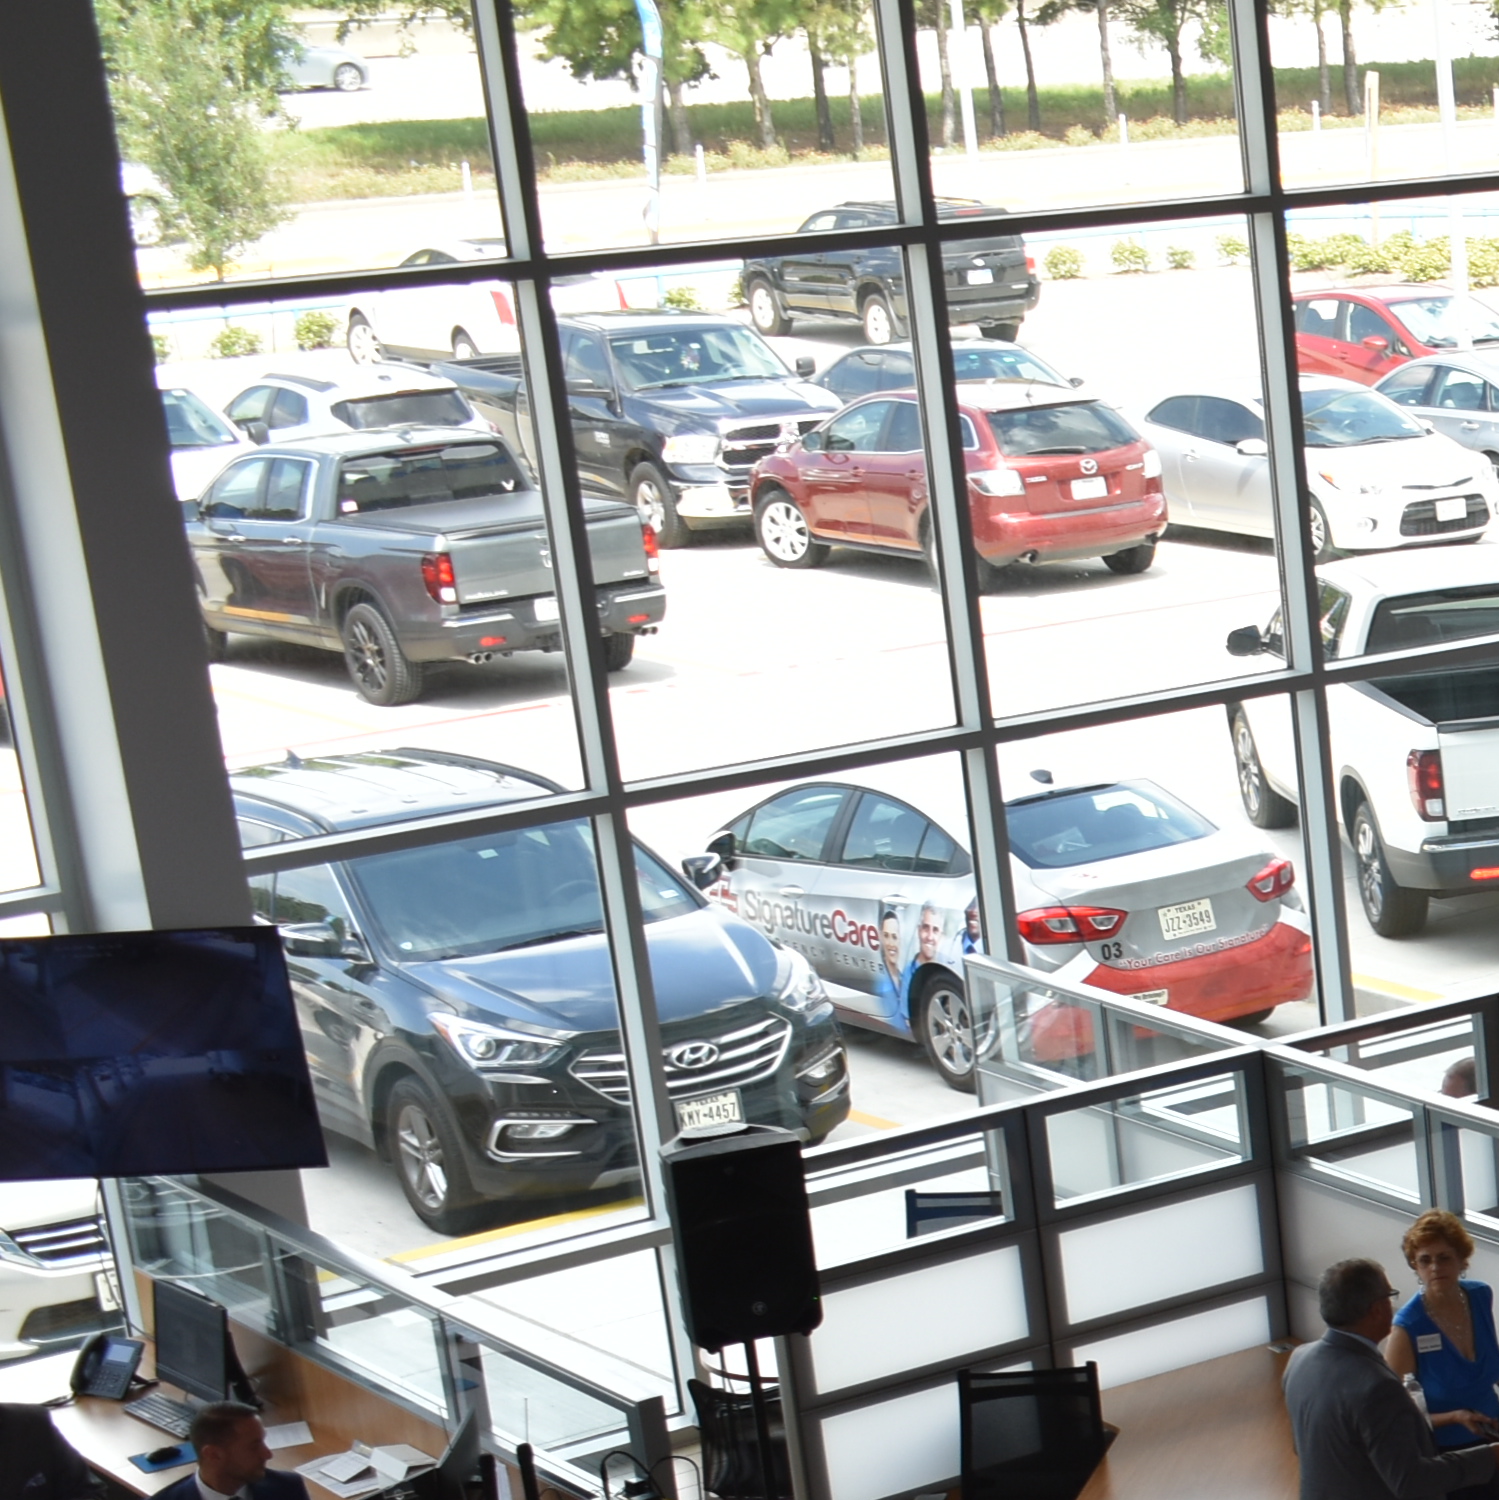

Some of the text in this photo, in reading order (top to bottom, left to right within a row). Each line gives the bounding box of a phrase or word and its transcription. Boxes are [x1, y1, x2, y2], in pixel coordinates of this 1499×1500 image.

[1174, 903, 1197, 914] TEXAS
[745, 889, 880, 951] SignatureCare
[1101, 942, 1123, 961] 03
[1155, 951, 1181, 963] Care
[1195, 943, 1216, 954] Our
